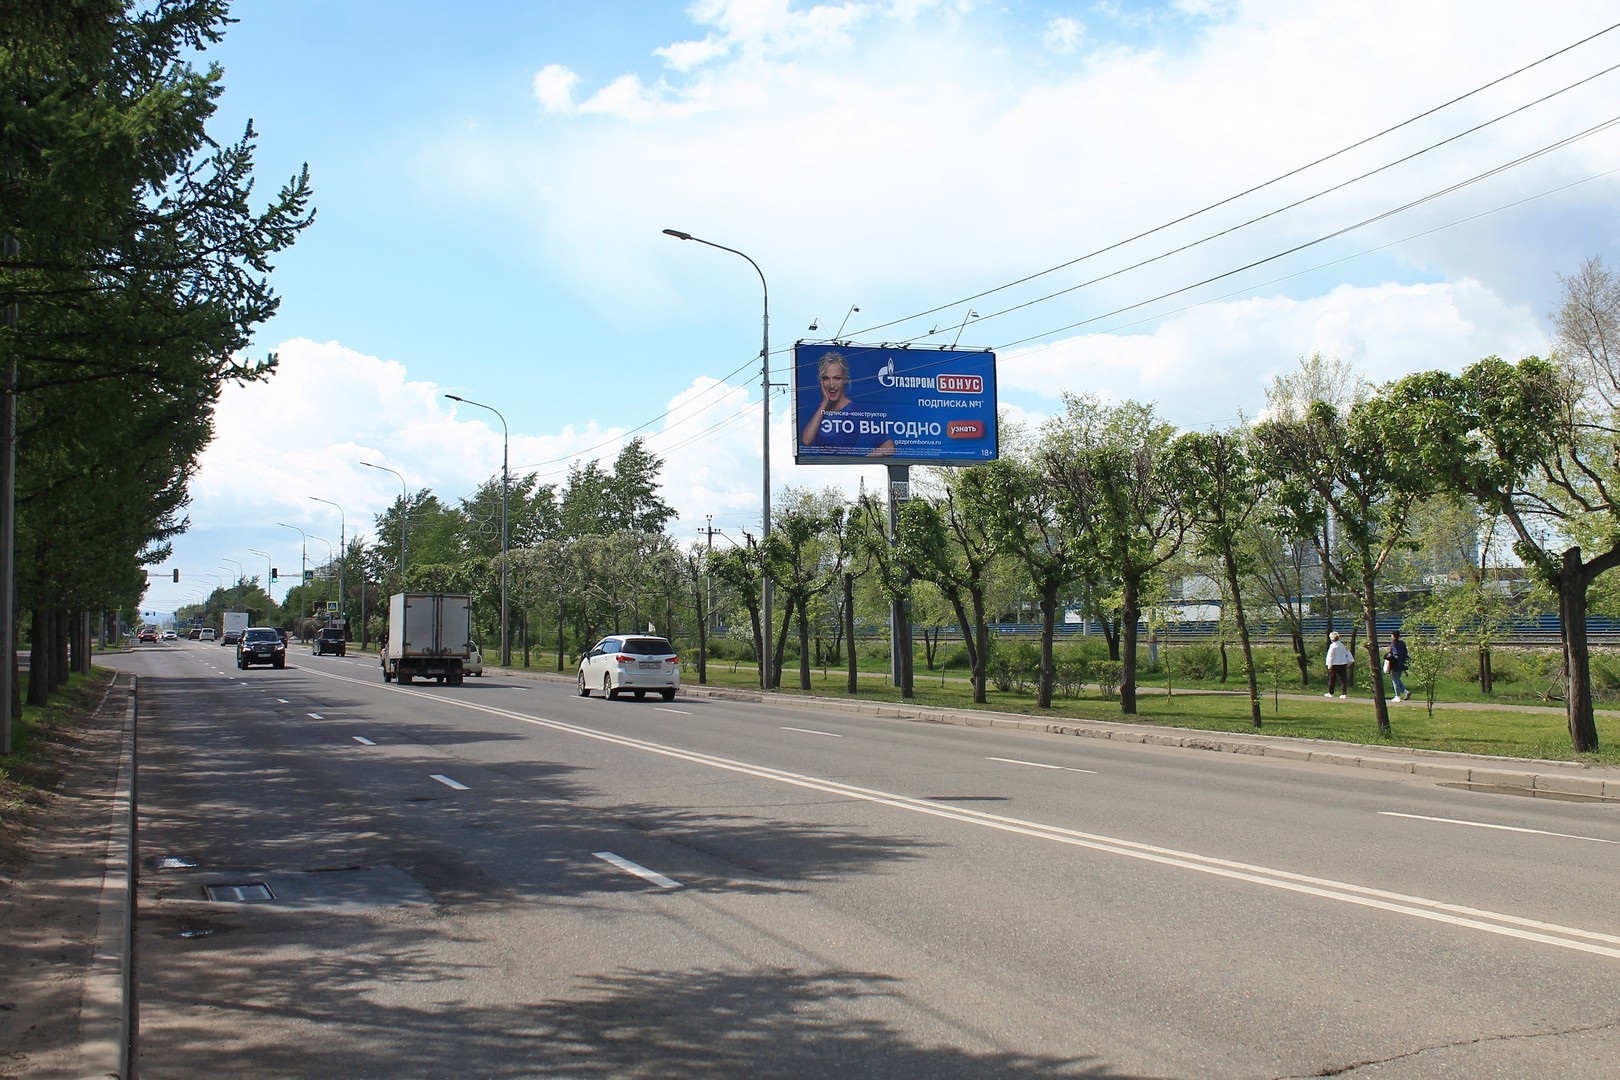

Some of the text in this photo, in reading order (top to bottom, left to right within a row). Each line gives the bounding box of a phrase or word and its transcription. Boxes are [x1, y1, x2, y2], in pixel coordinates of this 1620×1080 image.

[895, 376, 980, 390] ГАЗПРОМ БОНУС
[918, 398, 967, 408] ПОДПИСКА
[820, 409, 887, 418] Подписка-конструктор
[821, 419, 942, 437] ЭТО ВЫГОДНО
[950, 424, 977, 434] узнать
[981, 449, 993, 457] 18+
